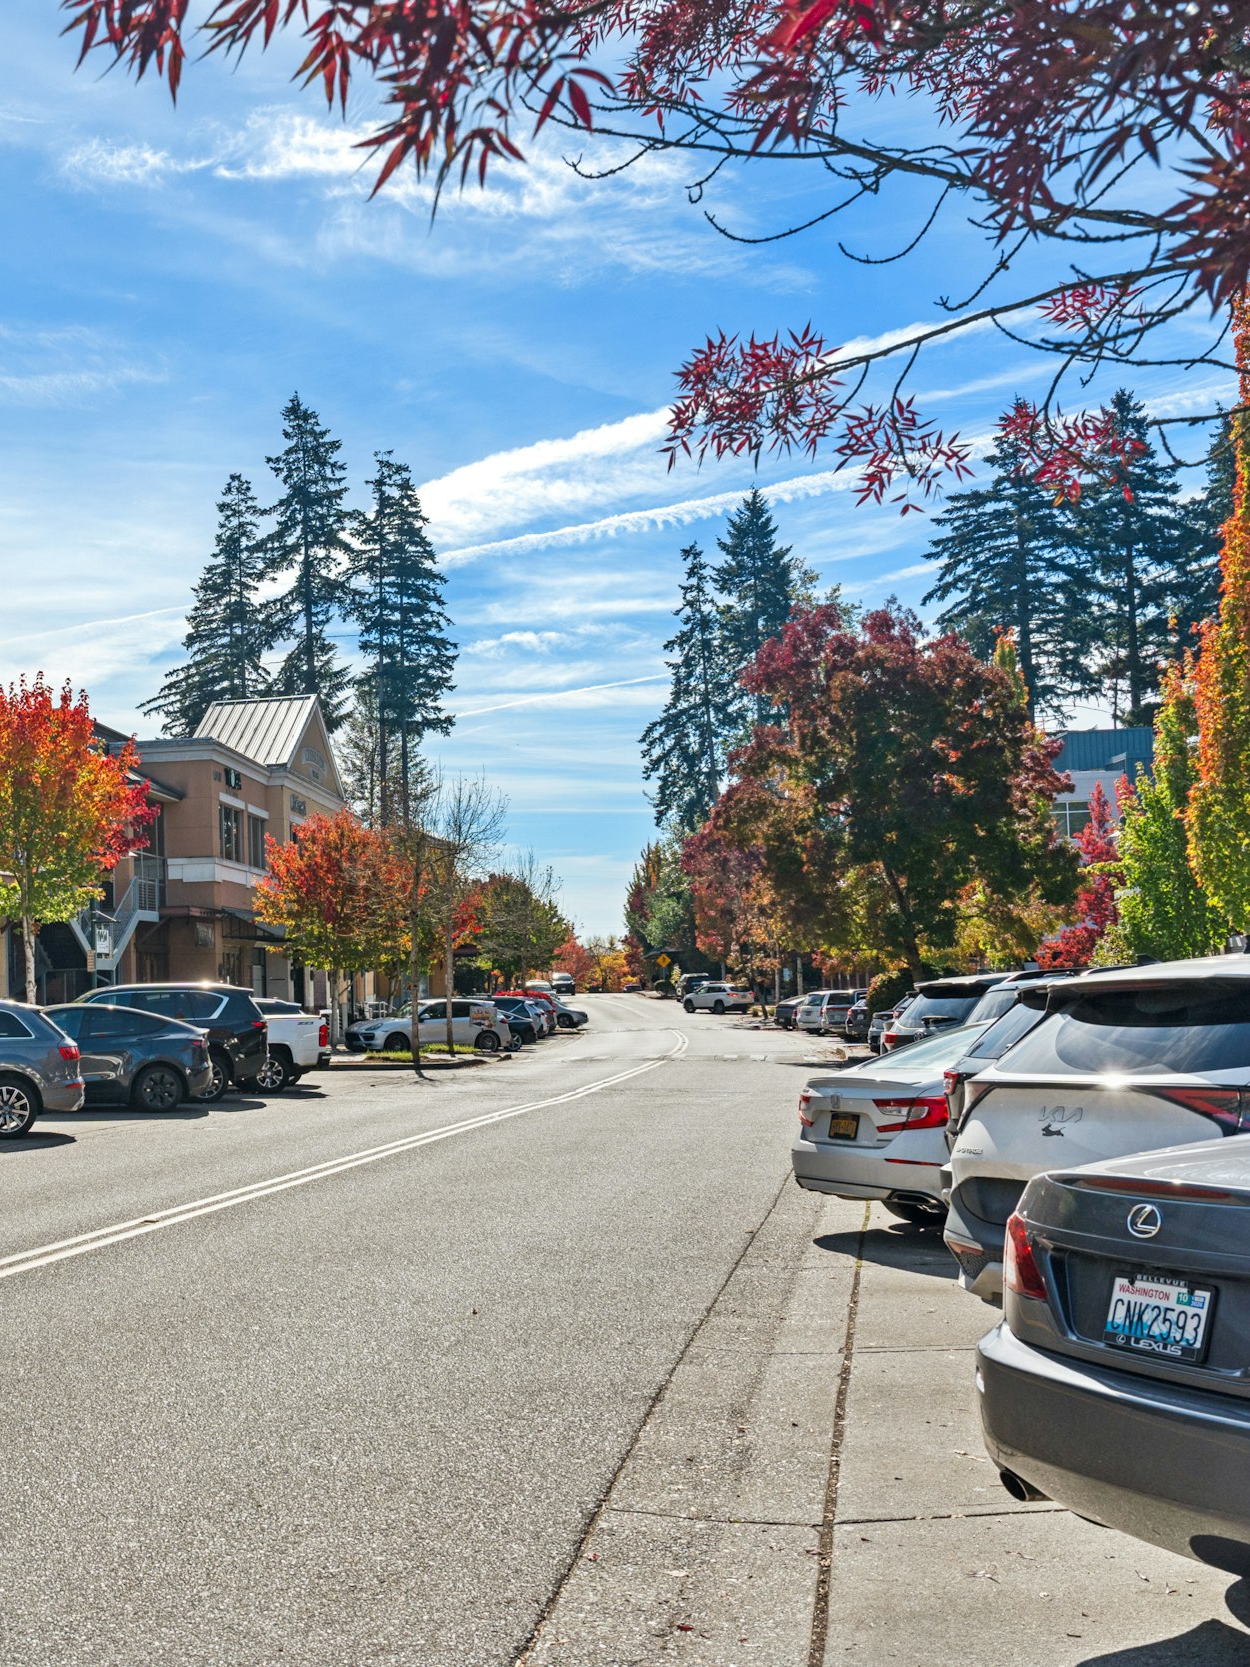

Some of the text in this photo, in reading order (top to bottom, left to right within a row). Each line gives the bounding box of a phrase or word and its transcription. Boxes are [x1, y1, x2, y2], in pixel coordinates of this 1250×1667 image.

[1136, 1274, 1187, 1288] BELLEVUE
[1119, 1283, 1171, 1301] WASHINGTON
[1178, 1293, 1189, 1303] 10
[1111, 1298, 1202, 1346] CNK2593
[1130, 1337, 1182, 1356] LEXUS
